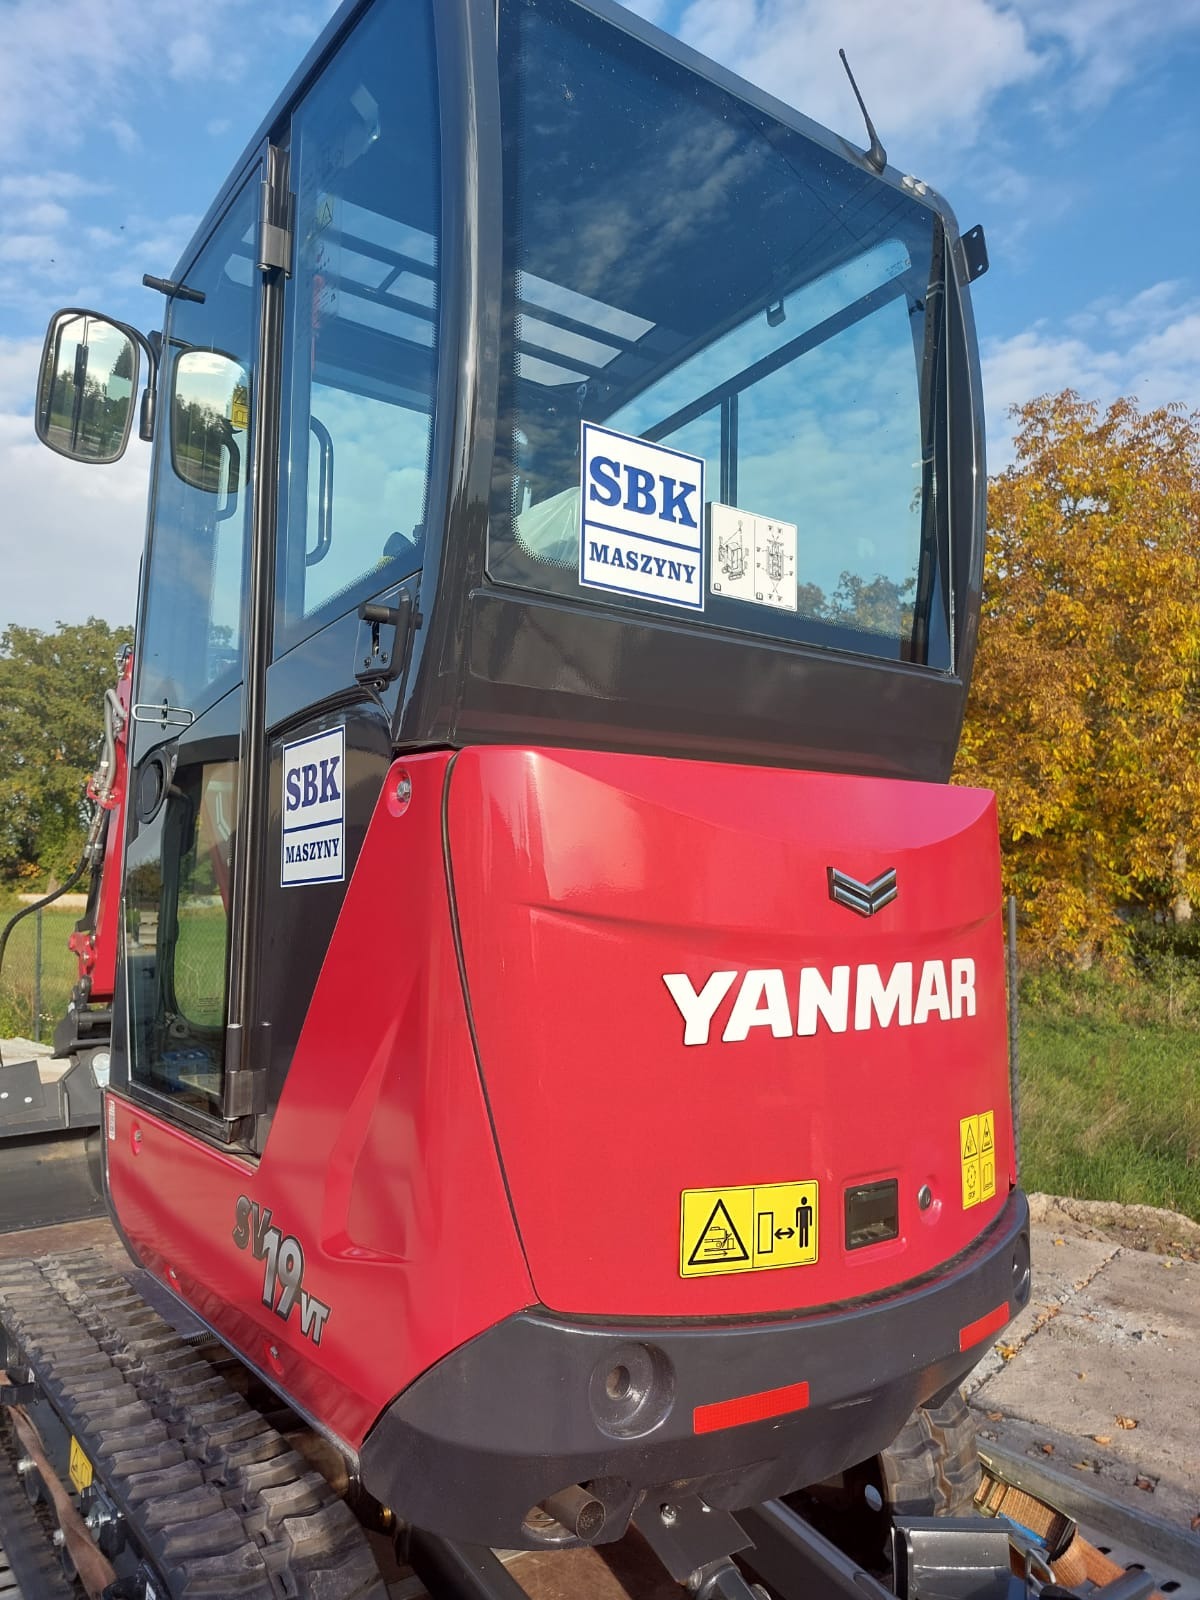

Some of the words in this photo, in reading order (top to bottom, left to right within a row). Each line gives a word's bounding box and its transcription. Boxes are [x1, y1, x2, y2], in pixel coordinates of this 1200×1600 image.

[589, 455, 698, 529] SBK
[589, 541, 696, 584] MASZYNY
[286, 756, 341, 811] SBK
[285, 838, 340, 864] MASZYNY
[662, 958, 977, 1046] YANMAR
